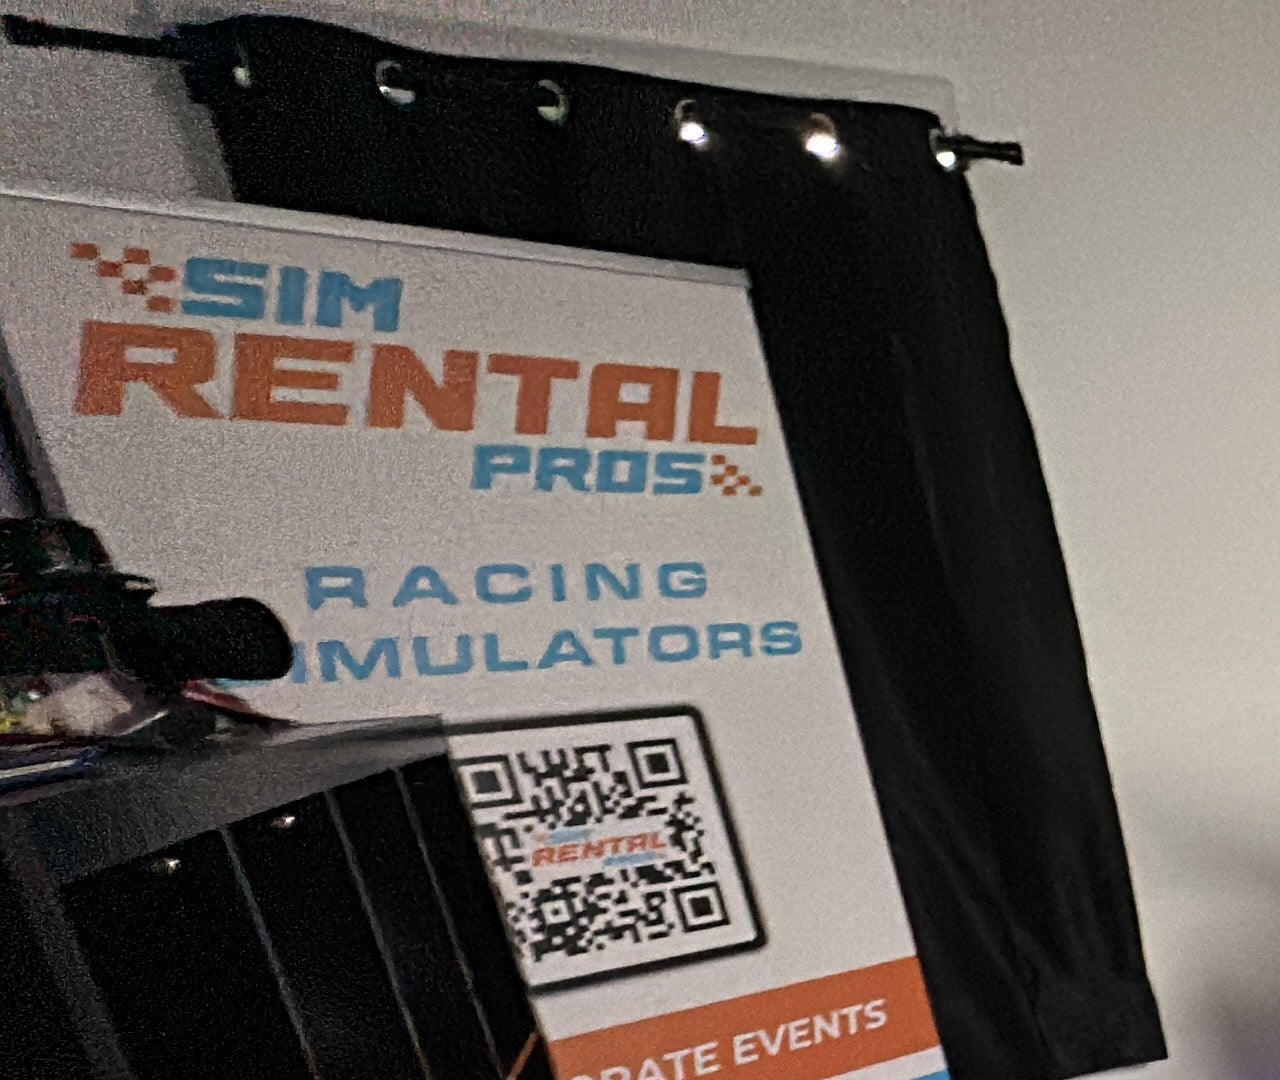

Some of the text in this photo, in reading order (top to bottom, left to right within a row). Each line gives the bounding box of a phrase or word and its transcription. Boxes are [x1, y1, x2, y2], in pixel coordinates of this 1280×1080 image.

[181, 256, 404, 331] SIM
[75, 321, 759, 445] RENTAL
[470, 443, 707, 496] PROS
[303, 560, 709, 612] RACING
[207, 621, 803, 688] IMULATORS
[531, 831, 667, 868] RENTAL
[732, 998, 890, 1067] EVENTS
